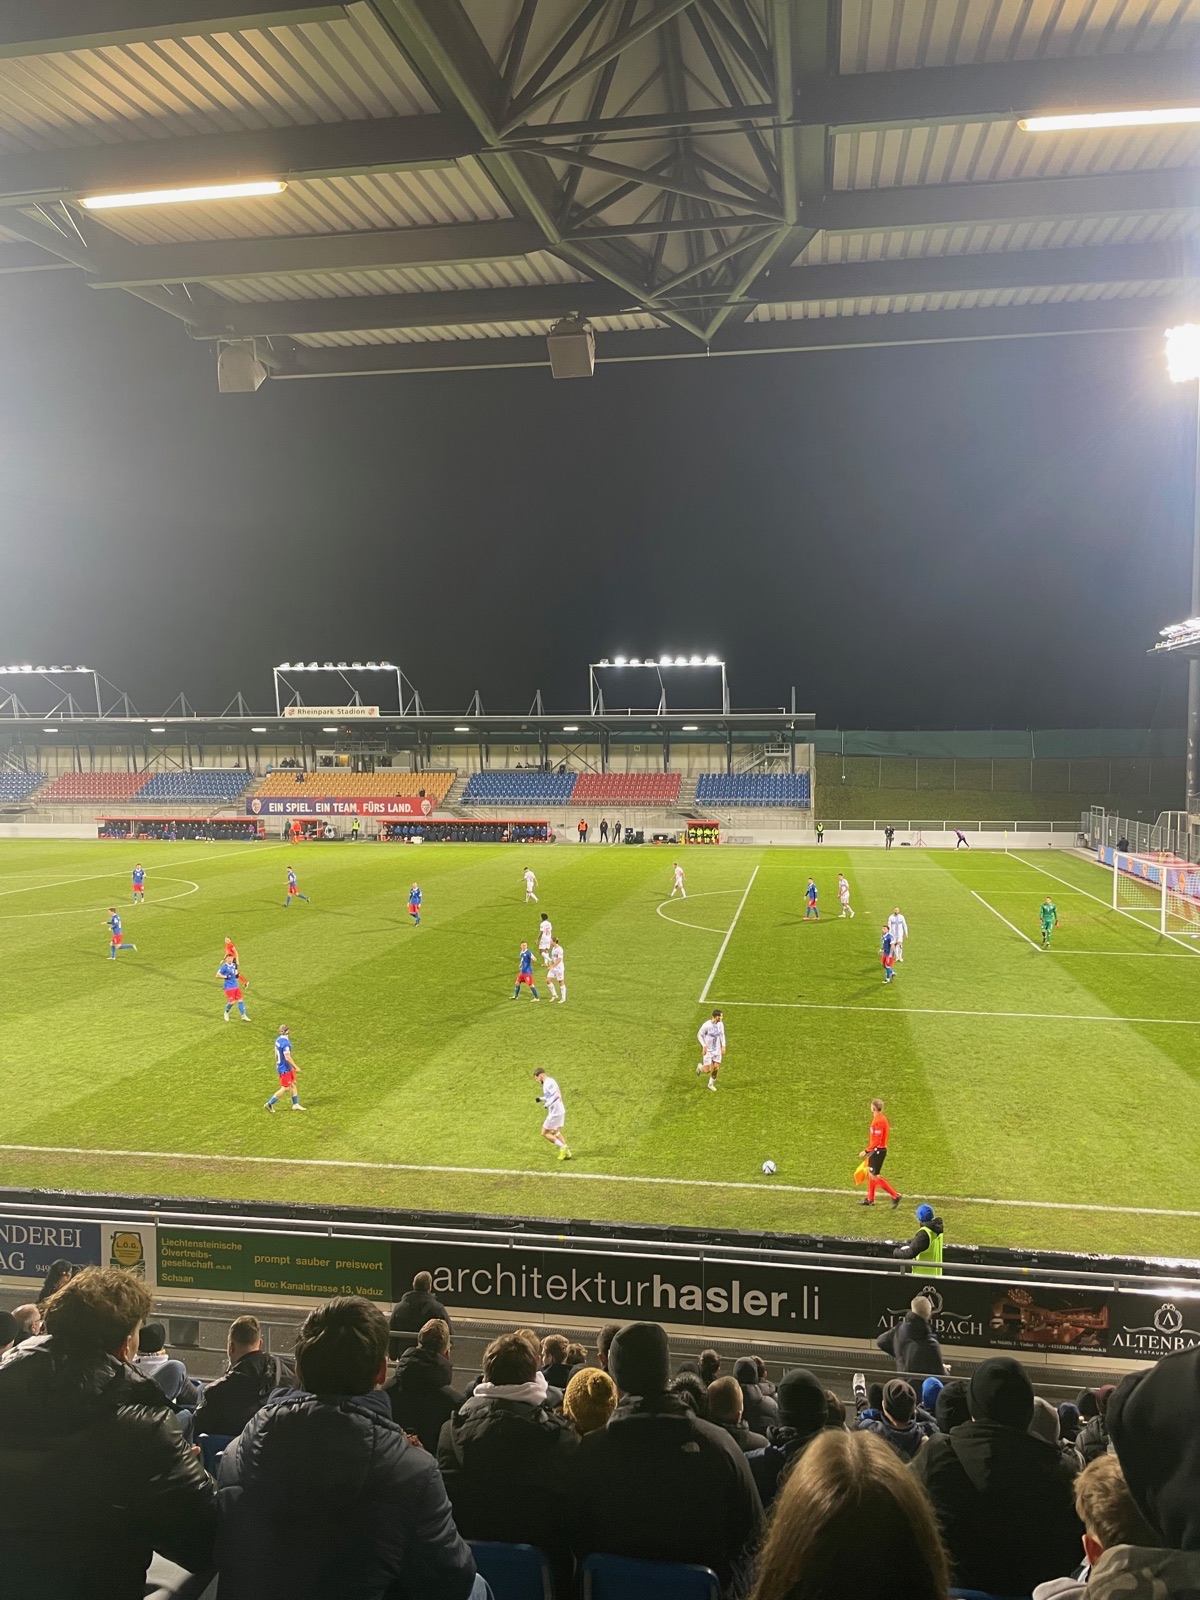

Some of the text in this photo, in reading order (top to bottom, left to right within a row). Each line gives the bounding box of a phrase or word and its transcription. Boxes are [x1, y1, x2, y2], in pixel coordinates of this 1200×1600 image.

[297, 708, 335, 716] Rheinpark
[268, 800, 414, 813] EIN SPIEL. EIN TEAM. FÜRS LAND.
[161, 1238, 242, 1251] Liechtensteinische
[161, 1246, 212, 1259] Ölvertreibs-
[161, 1259, 214, 1269] gesellschaft
[254, 1255, 383, 1271] prompt sauber preiswert
[161, 1273, 194, 1283] Schaan
[254, 1279, 384, 1296] Büro: Kanalstrasse 13, Vaduz
[432, 1262, 820, 1321] architekturhasler.li
